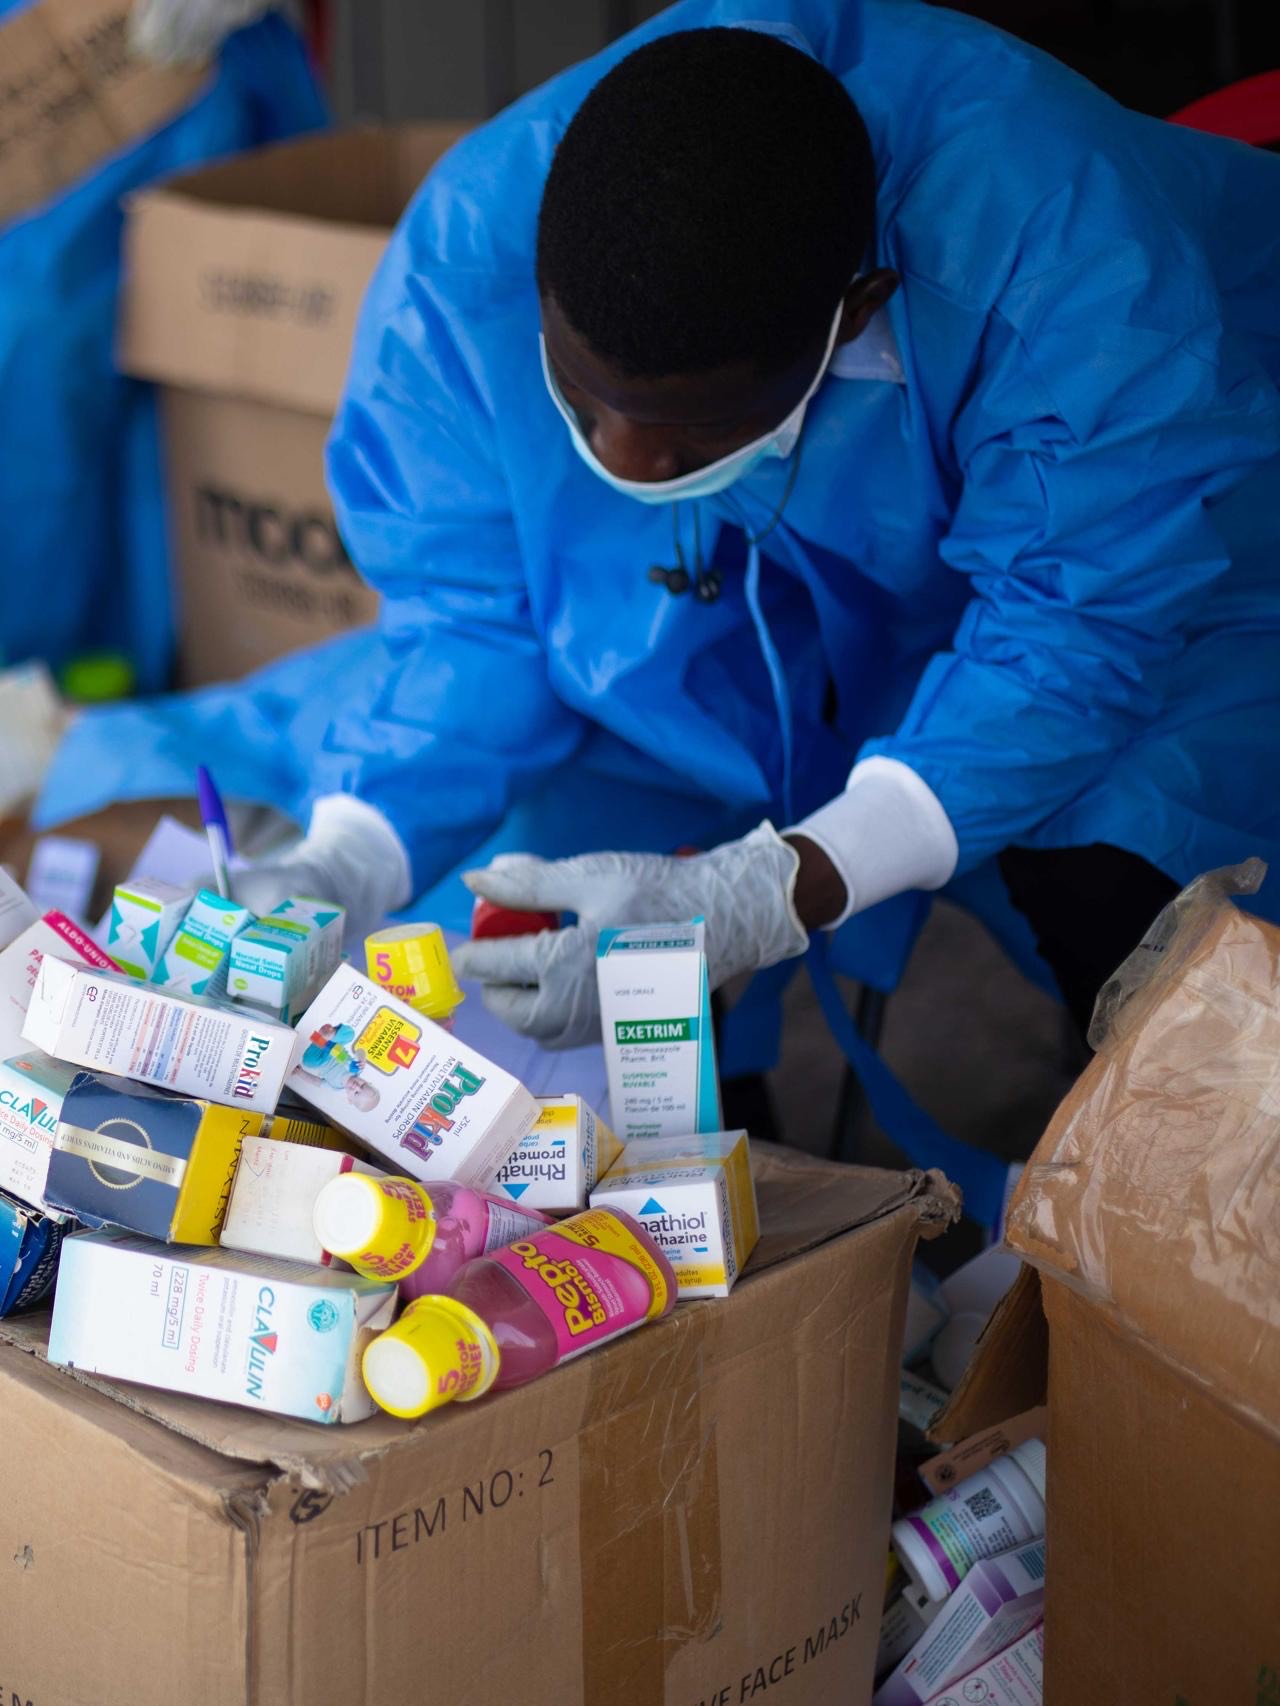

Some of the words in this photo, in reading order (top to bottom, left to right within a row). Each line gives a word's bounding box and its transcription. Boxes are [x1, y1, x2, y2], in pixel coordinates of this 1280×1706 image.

[234, 958, 256, 971] Nasal
[257, 966, 281, 979] Drops
[376, 953, 393, 982] 5
[365, 1014, 396, 1057] VITAMINS
[371, 1017, 405, 1063] ESSENTIAL
[617, 1024, 683, 1039] EXETRIM
[232, 1035, 270, 1099] Prokid
[391, 1041, 415, 1065] 7
[409, 1051, 456, 1117] MULTIVITAMIN
[622, 1071, 667, 1079] SUSPENSION
[622, 1080, 655, 1088] BUVABLE
[7, 1114, 30, 1132] Daily
[390, 1110, 415, 1142] DROPS
[400, 1060, 486, 1163] Prokid
[0, 1125, 24, 1144] mg/5
[22, 1138, 35, 1149] ml
[638, 1211, 705, 1232] nathiol
[581, 1232, 600, 1249] 5
[654, 1232, 706, 1245] thazine
[150, 1262, 164, 1278] 70
[170, 1270, 186, 1295] 228
[148, 1279, 162, 1297] ml
[193, 1271, 211, 1303] Twice
[510, 1242, 596, 1338] Pepto
[560, 1259, 607, 1328] Bismol
[164, 1295, 183, 1327] mg/5
[188, 1304, 206, 1334] Daily
[164, 1328, 178, 1345] ml
[246, 1285, 279, 1400] CLAVULIN
[183, 1335, 202, 1374] Dosing
[438, 1369, 461, 1394] 5
[355, 1496, 447, 1565] ITEM
[462, 1469, 526, 1522] NO:
[537, 1449, 555, 1488] 2
[740, 1647, 796, 1706] FACE
[803, 1591, 863, 1666] MASK
